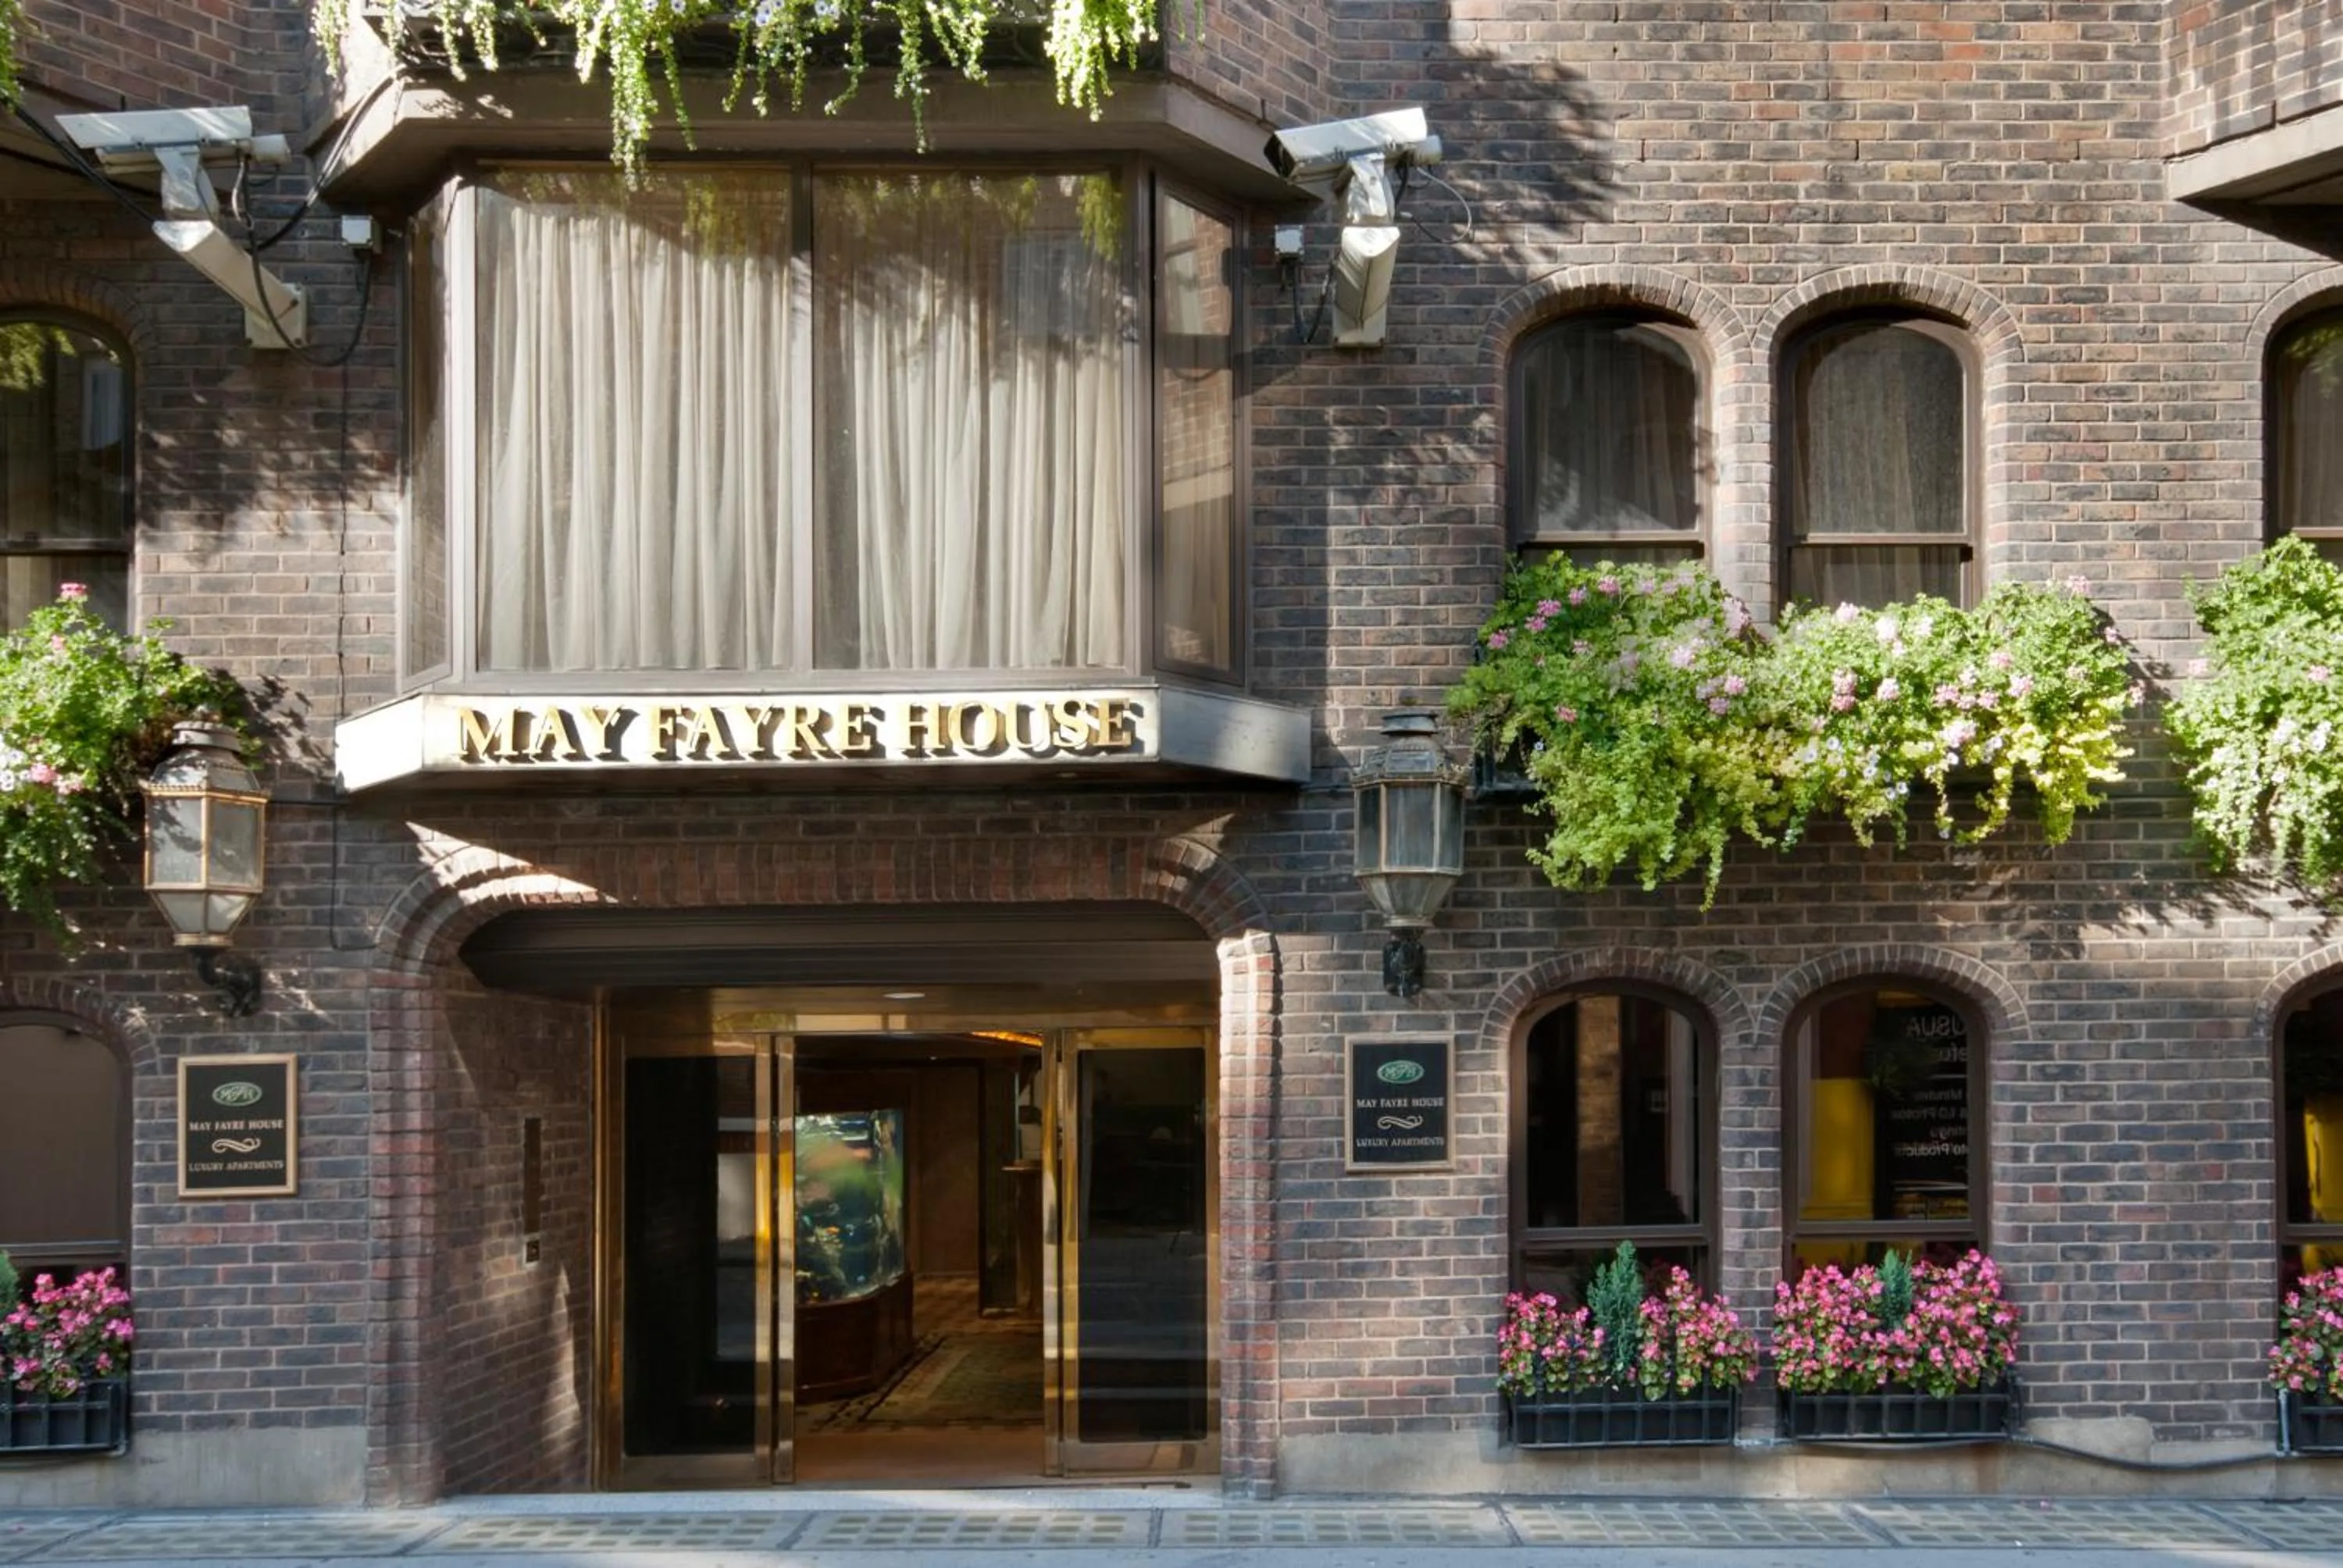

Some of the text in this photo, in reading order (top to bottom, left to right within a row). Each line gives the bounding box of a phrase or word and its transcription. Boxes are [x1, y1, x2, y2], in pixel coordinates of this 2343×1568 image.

[459, 699, 1132, 755] MAY FAYRE HOUSE
[1357, 1097, 1444, 1108] MAY FAYRE HOUSE
[189, 1119, 284, 1131] MAY FAYRE HOUSE
[1356, 1136, 1444, 1147] LUXURY APARTMENTS
[189, 1160, 284, 1171] LUXURY APARTMENTS
